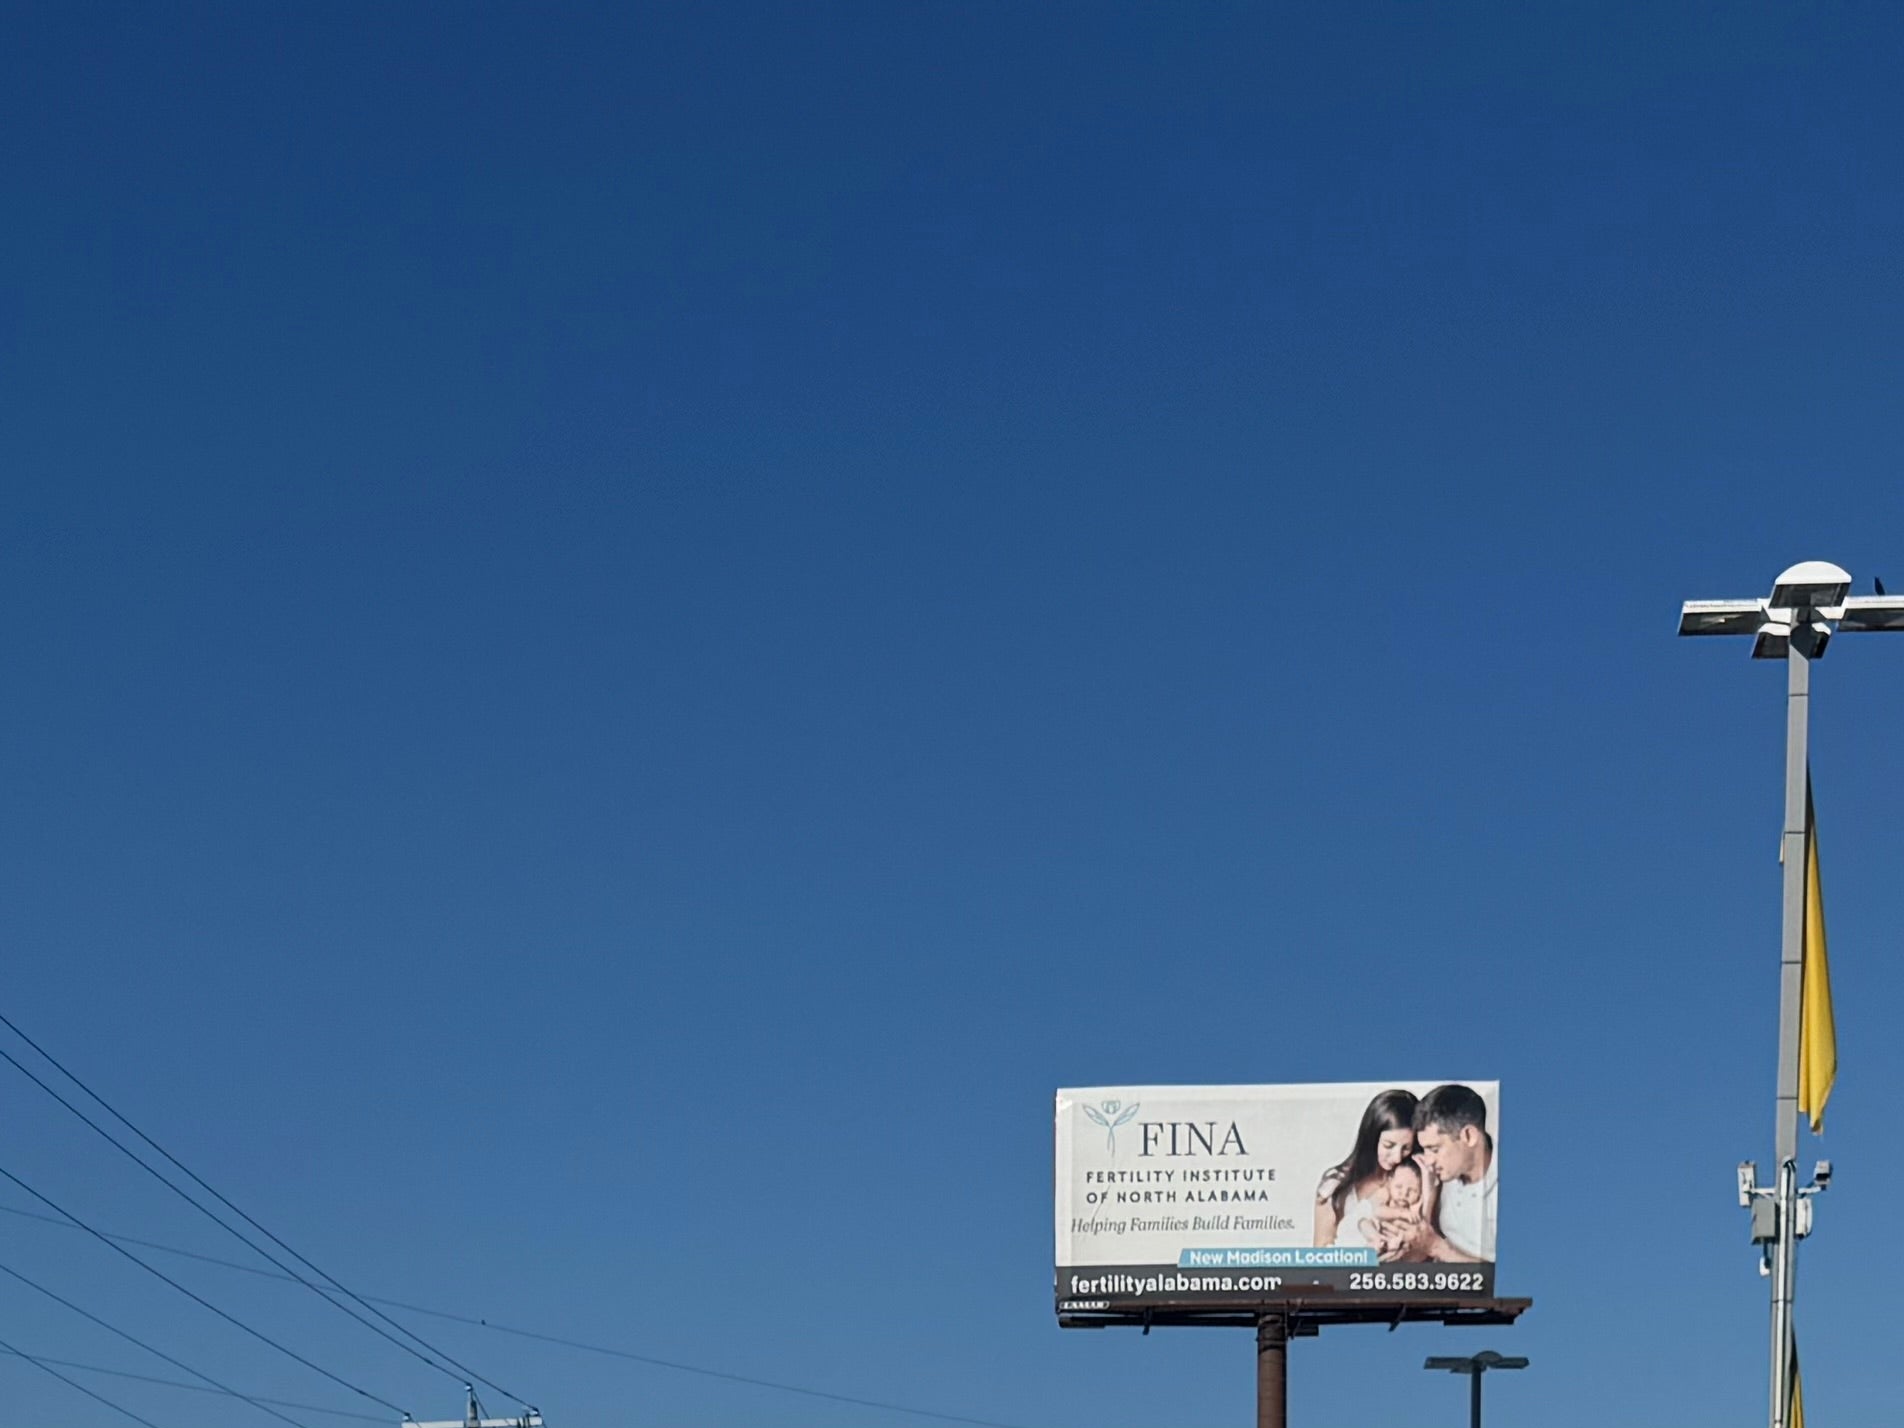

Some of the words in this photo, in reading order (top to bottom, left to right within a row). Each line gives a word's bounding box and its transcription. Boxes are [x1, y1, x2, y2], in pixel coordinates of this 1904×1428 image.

[1137, 1121, 1250, 1157] FINA
[1086, 1170, 1175, 1183] FERTILITY
[1183, 1168, 1277, 1182] INSTITUTE
[1086, 1191, 1108, 1204] OF
[1117, 1191, 1177, 1203] NORTH
[1185, 1190, 1269, 1202] ALABAMA
[1071, 1217, 1125, 1235] Helping
[1130, 1217, 1189, 1232] Families
[1192, 1215, 1230, 1231] Build
[1233, 1215, 1295, 1230] Families.
[1189, 1251, 1223, 1265] New
[1227, 1250, 1291, 1264] Madison
[1296, 1249, 1368, 1264] Location!
[1071, 1273, 1282, 1297] fertilityalabama.com
[1349, 1272, 1484, 1291] 256.583.9622
